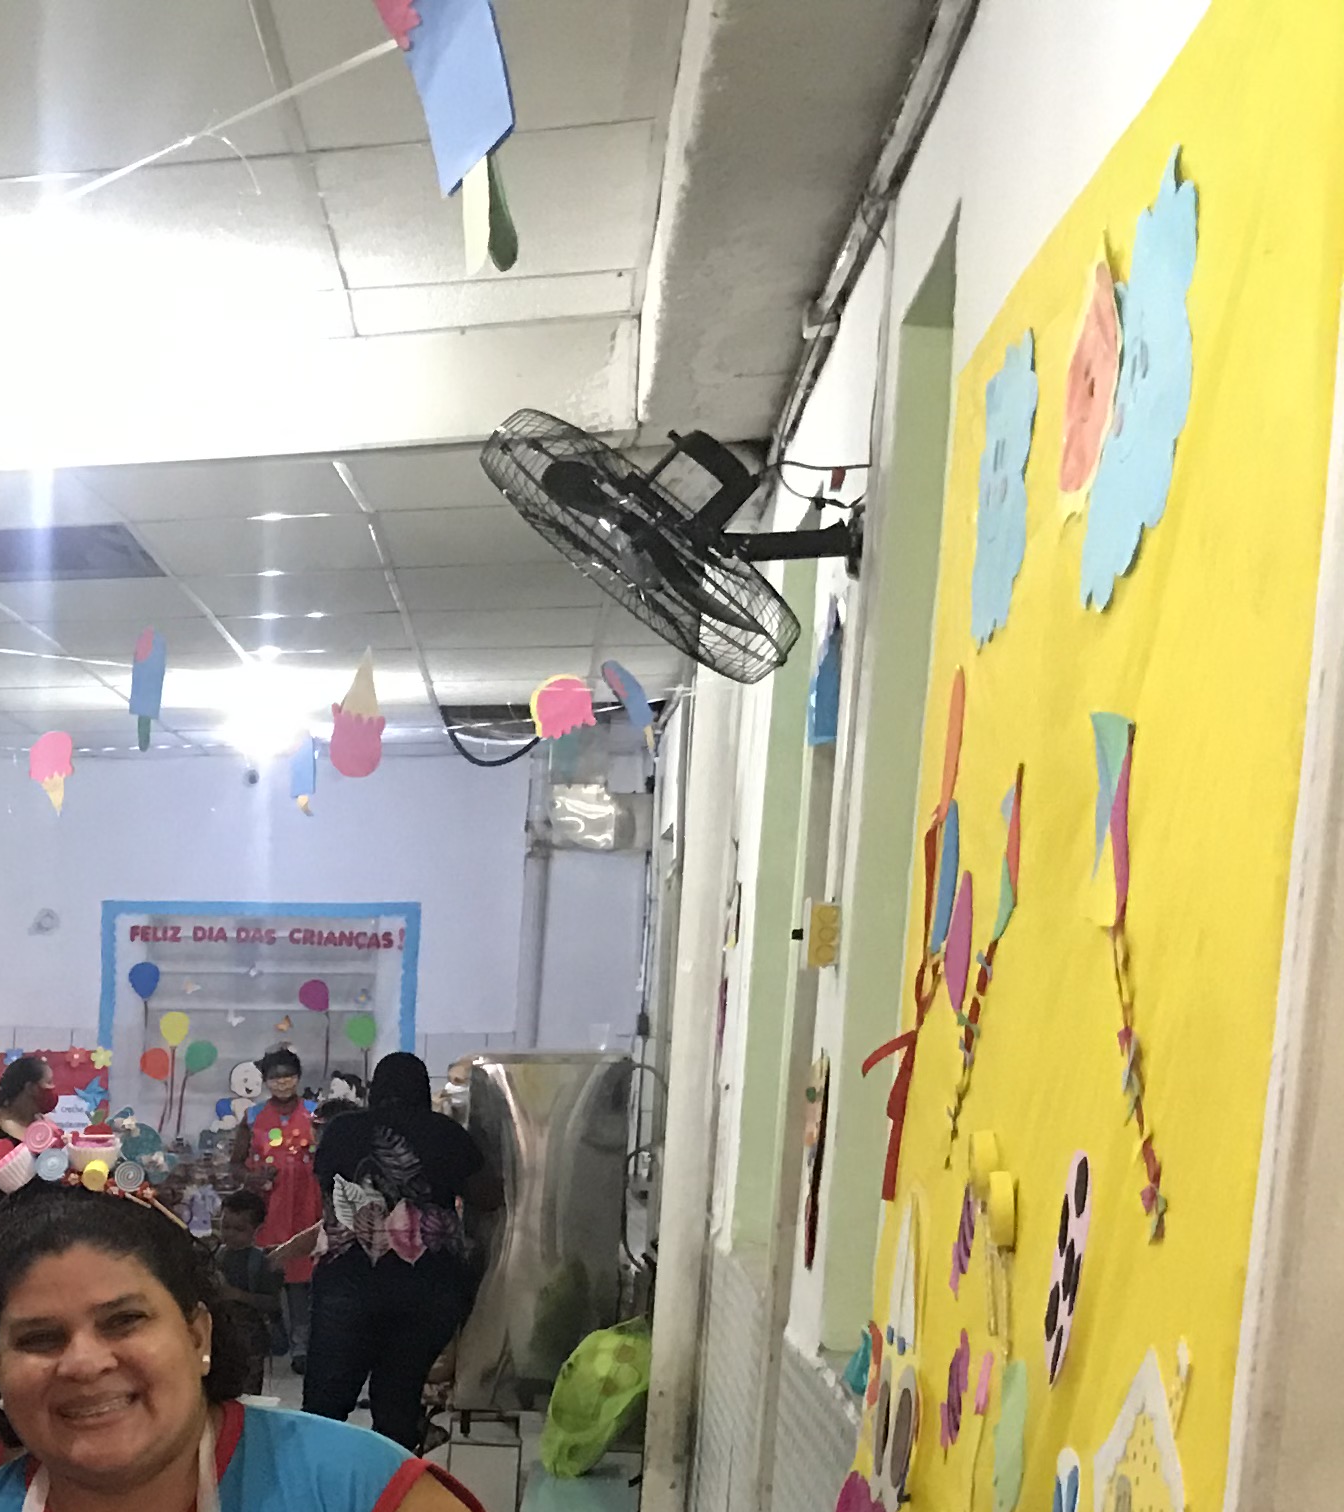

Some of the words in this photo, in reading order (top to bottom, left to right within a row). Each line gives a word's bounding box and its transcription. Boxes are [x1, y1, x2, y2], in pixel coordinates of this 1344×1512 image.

[129, 925, 183, 943] FELIZ
[192, 926, 228, 943] DIA
[235, 926, 277, 946] DAS
